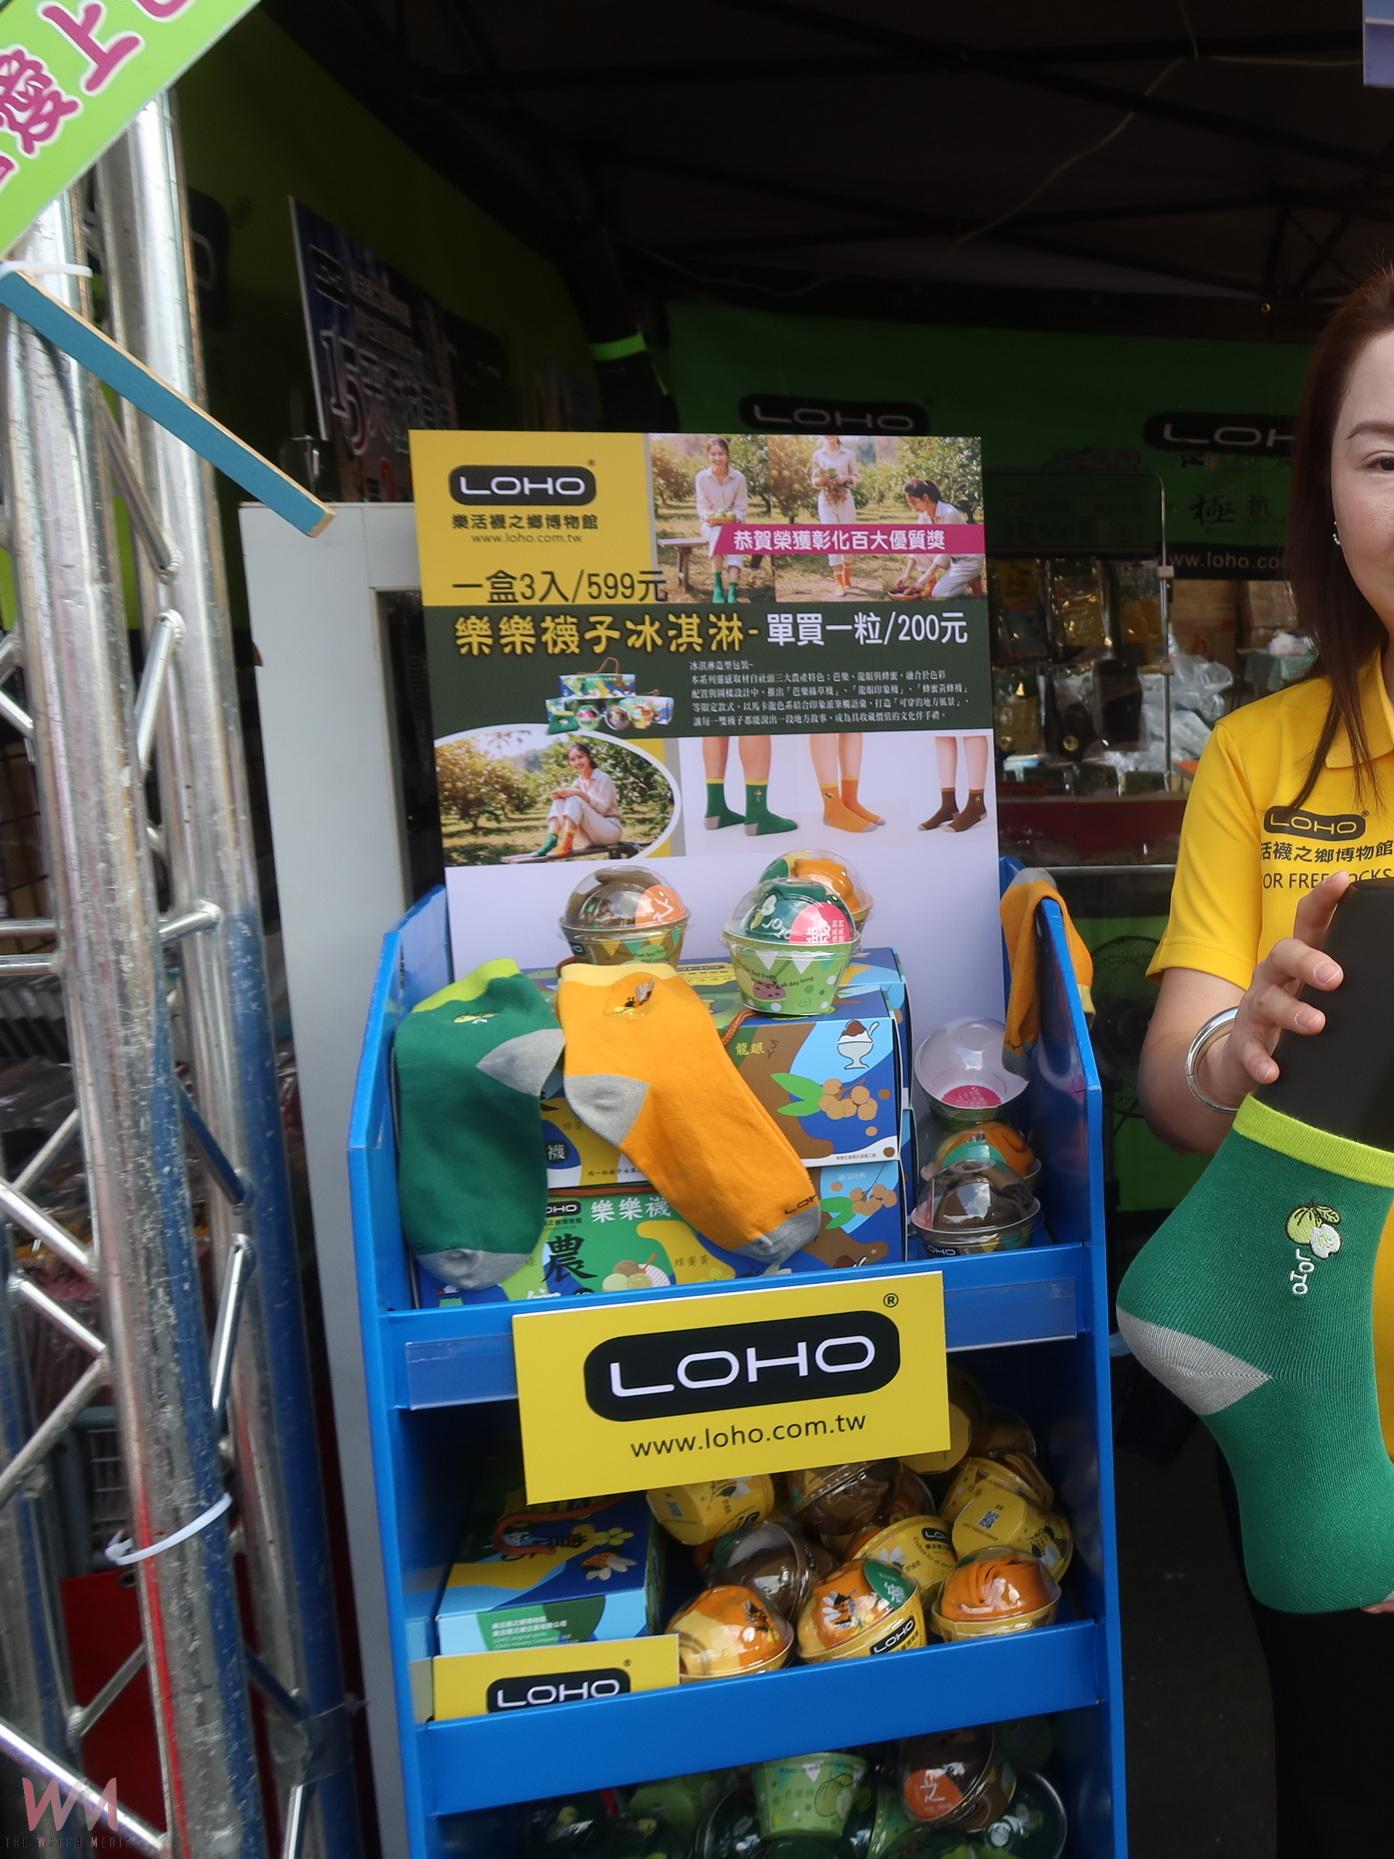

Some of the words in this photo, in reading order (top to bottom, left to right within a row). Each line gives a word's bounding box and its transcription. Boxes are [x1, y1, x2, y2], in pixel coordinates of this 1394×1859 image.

[753, 403, 914, 430] LOHO
[459, 476, 586, 496] LOHO
[452, 514, 599, 530] 樂活襪之鄉博物館
[472, 532, 582, 544] www.loho.com.tw
[733, 530, 946, 551] 恭賀榮獲彰化百大優質獎
[452, 569, 669, 603] 一盒3入/599元
[1270, 813, 1357, 835] LOHO
[610, 1335, 876, 1397] LOHO
[630, 1414, 866, 1458] www.loho.com.tw
[873, 1619, 914, 1654] LOHO
[497, 1679, 620, 1708] LOHO
